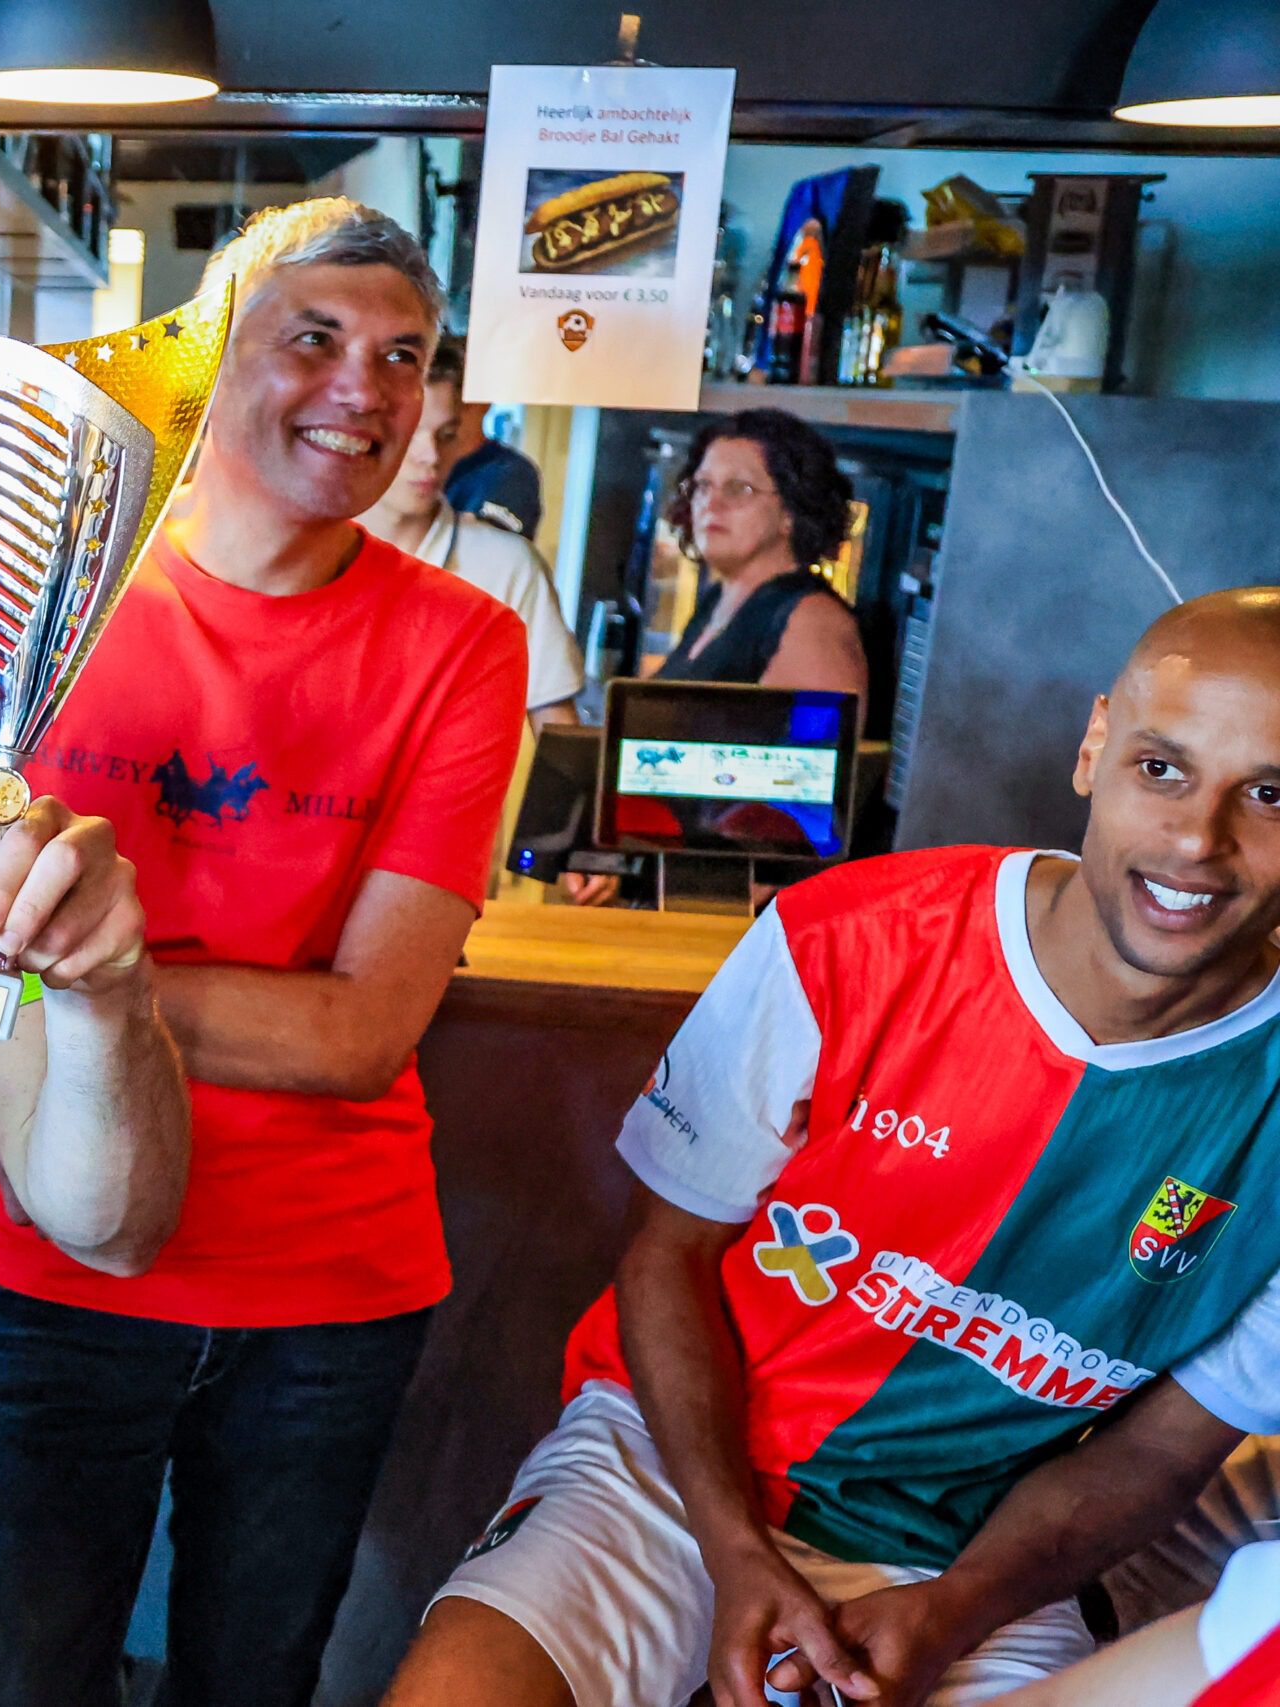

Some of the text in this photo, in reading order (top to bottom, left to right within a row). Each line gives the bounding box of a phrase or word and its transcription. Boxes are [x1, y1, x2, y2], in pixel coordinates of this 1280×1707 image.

[537, 105, 692, 124] Heerlijk ambachtelijk
[538, 127, 681, 144] Broodje Bal Gehakt
[519, 285, 581, 302] Vandaag
[586, 289, 619, 301] voor
[850, 1100, 950, 1158] 1904
[1133, 1236, 1197, 1275] SVV
[856, 1272, 1132, 1409] STREMME
